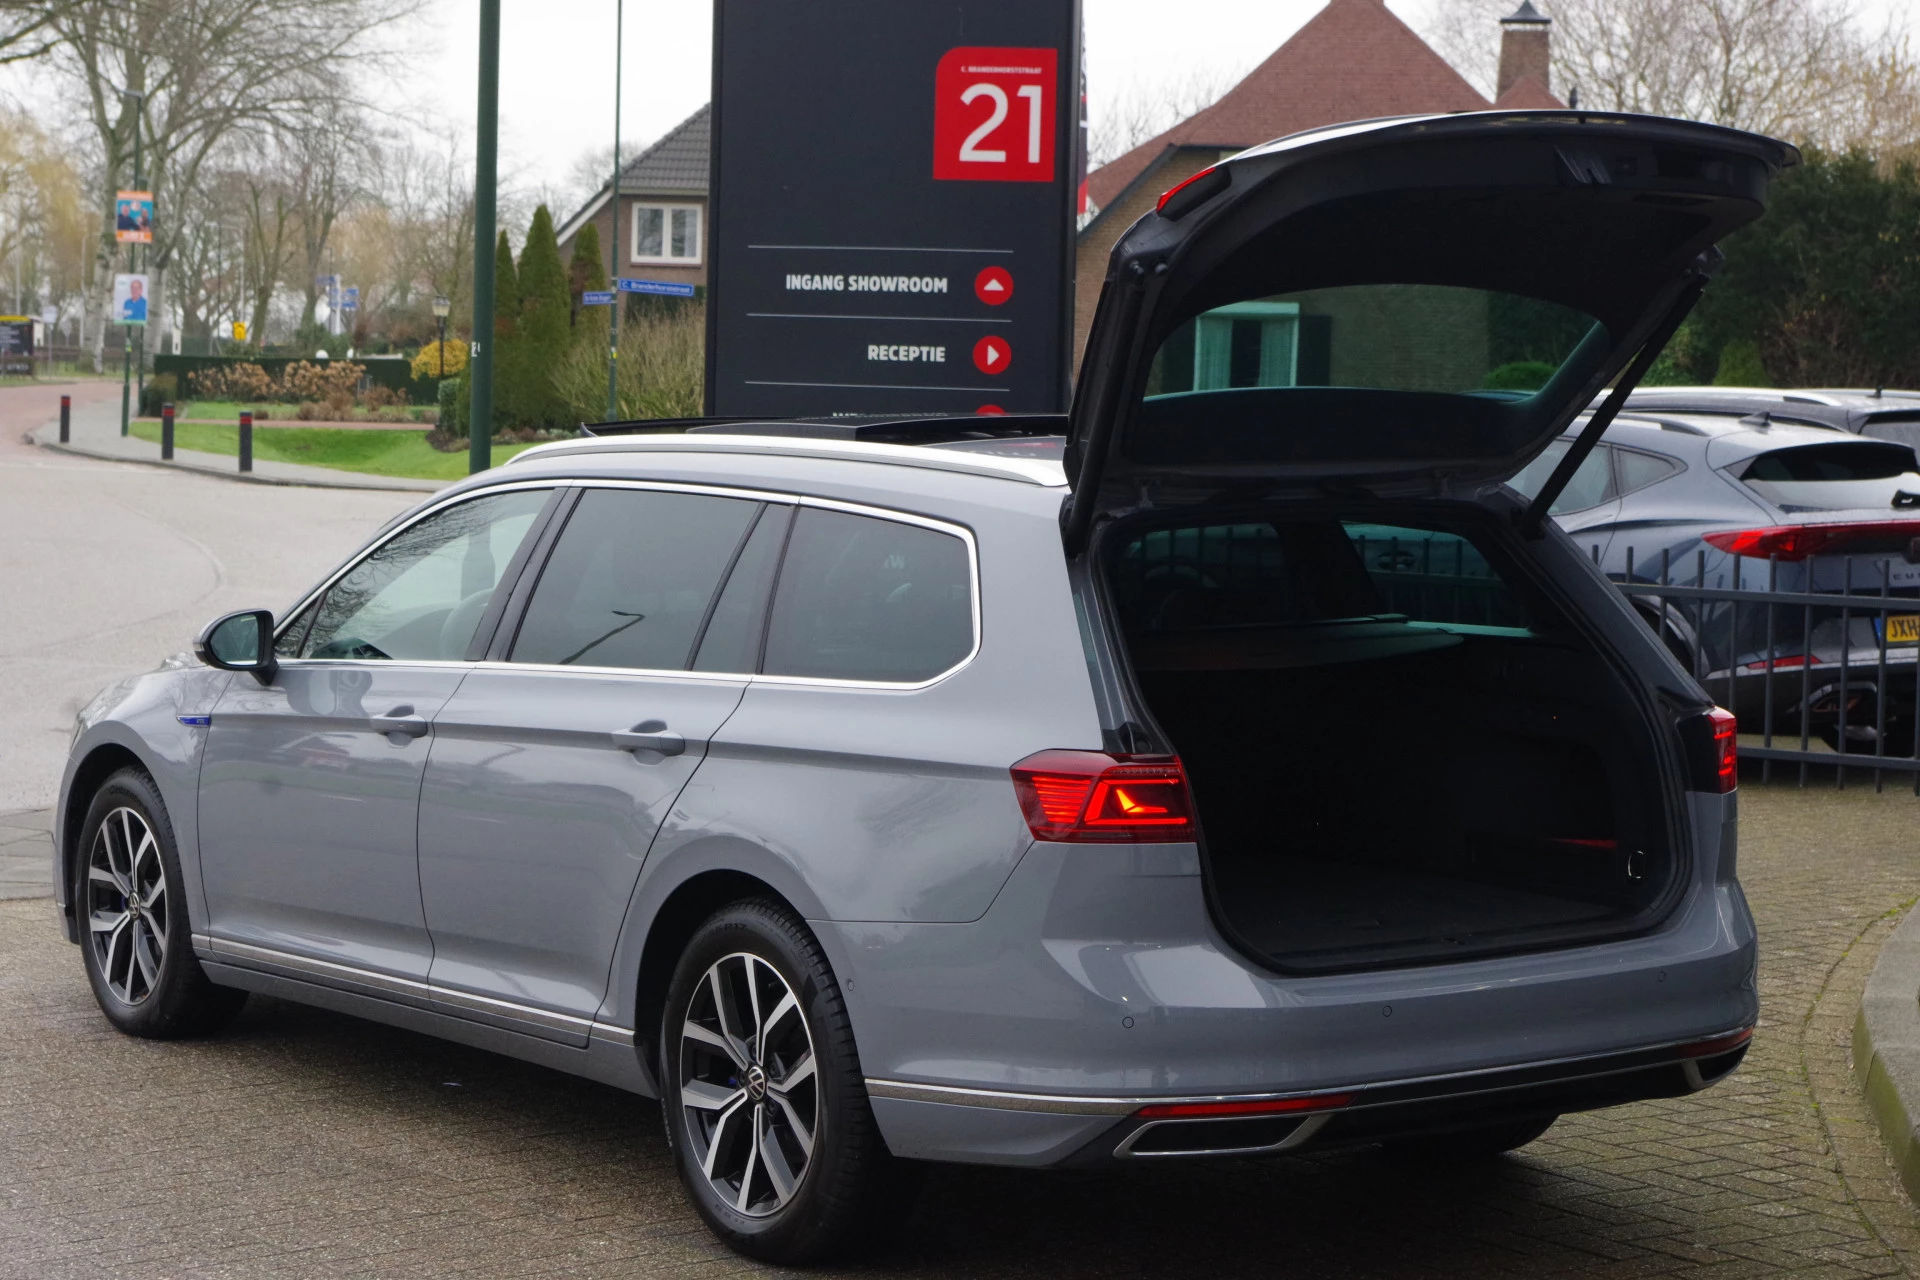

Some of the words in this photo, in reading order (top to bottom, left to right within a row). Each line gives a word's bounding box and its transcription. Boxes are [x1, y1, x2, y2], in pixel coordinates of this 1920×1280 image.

[959, 83, 1042, 163] 21
[786, 274, 844, 291] INGANG
[848, 275, 948, 293] SHOWROOM
[867, 344, 946, 362] RECEPTIE
